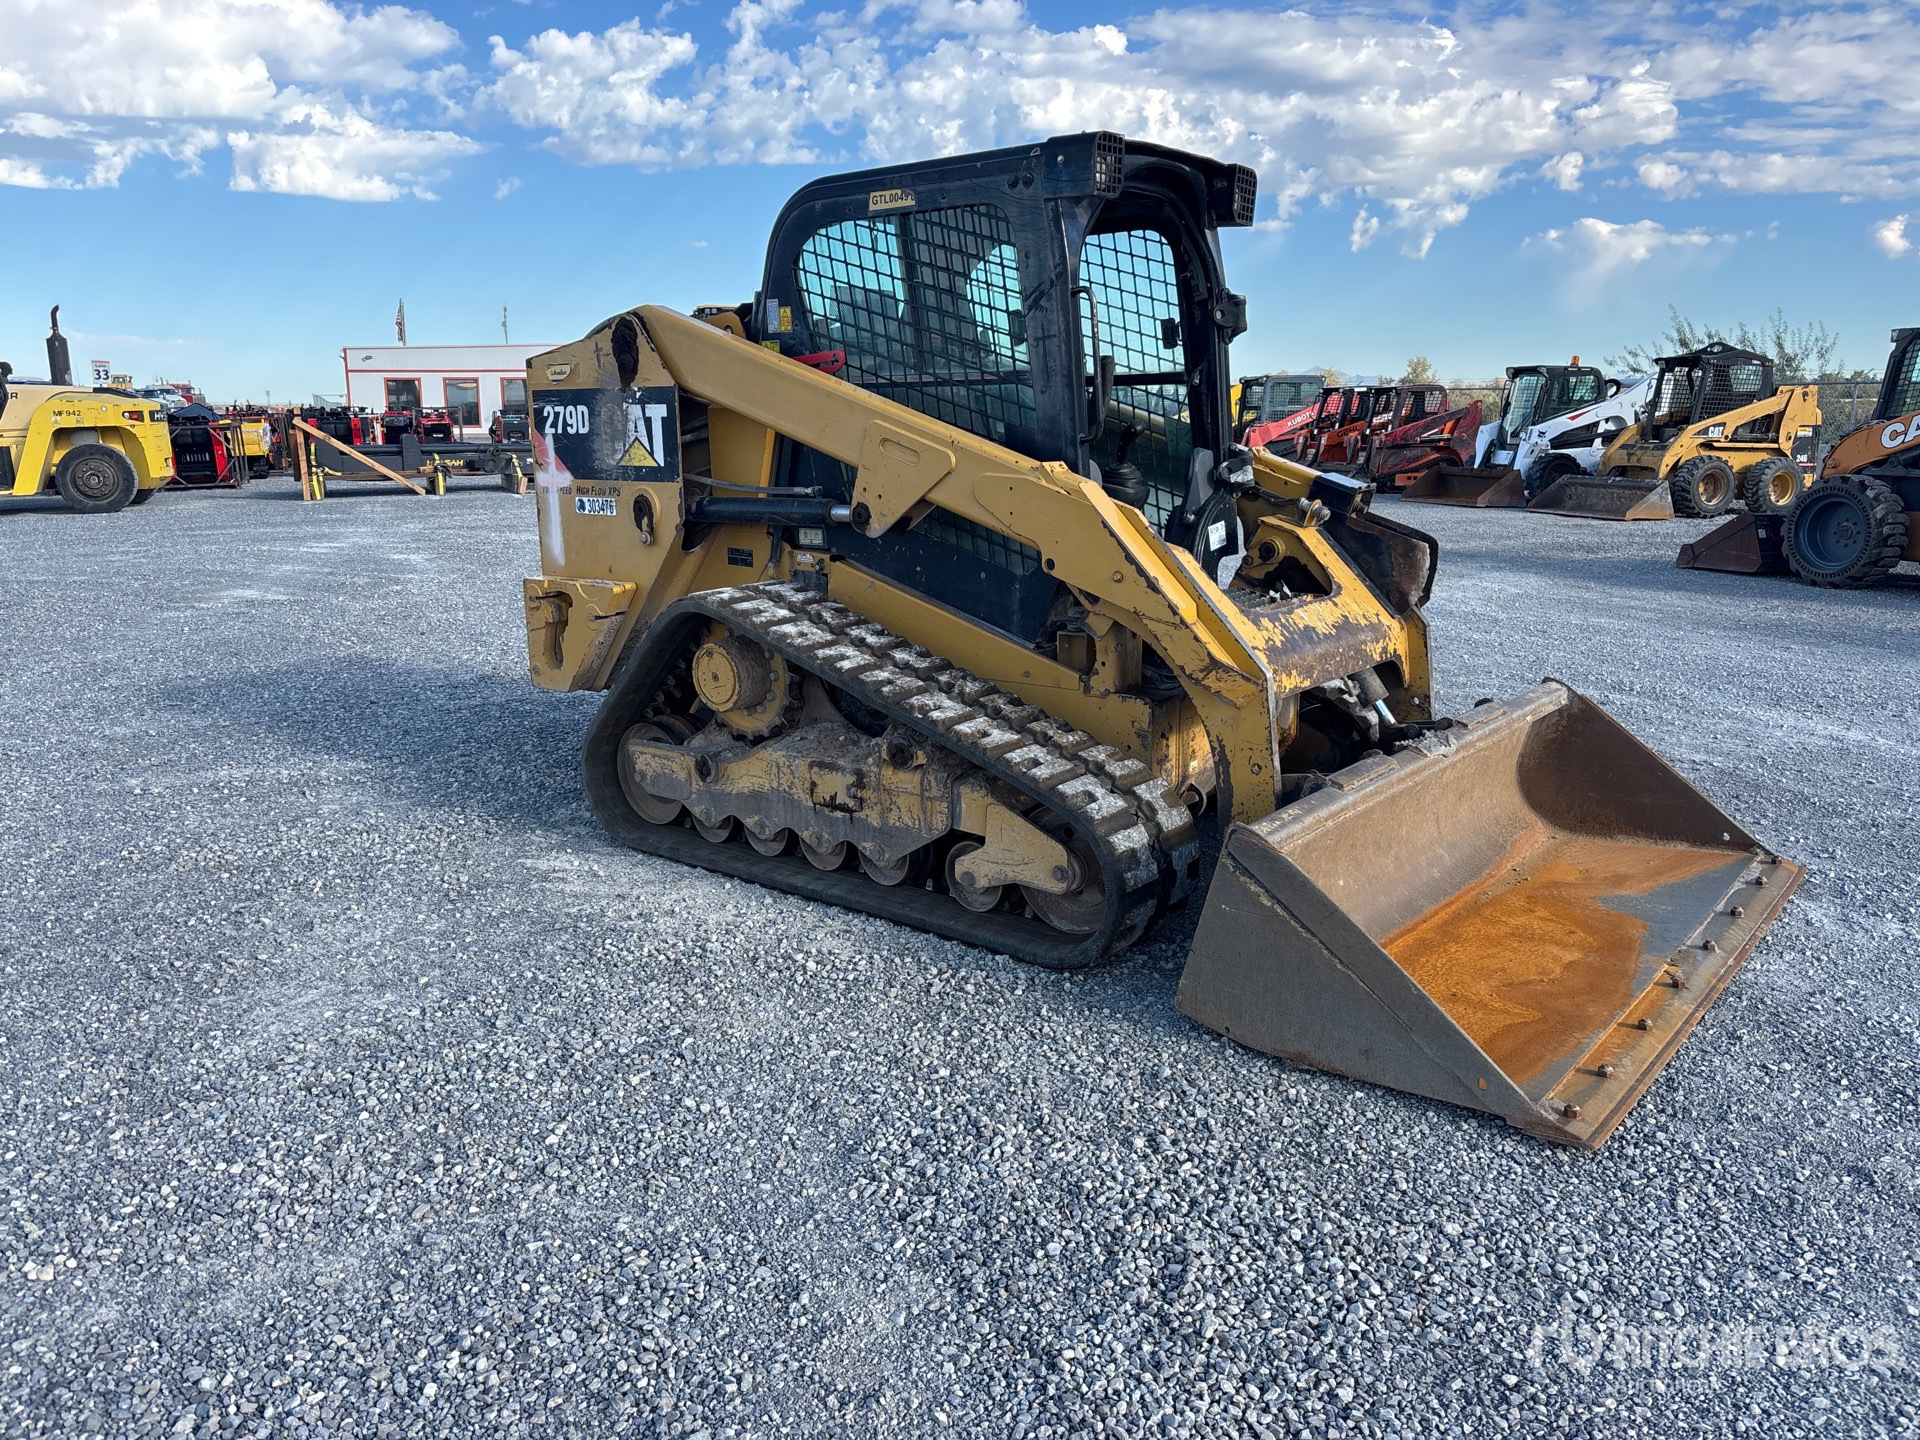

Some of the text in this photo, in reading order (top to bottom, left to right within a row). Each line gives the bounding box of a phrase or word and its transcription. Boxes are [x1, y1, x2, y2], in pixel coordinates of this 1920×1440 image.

[94, 369, 110, 380] 33
[543, 404, 590, 435] 279D
[1708, 426, 1724, 438] CAT
[1796, 454, 1808, 463] 246
[576, 485, 590, 495] HIGH
[591, 486, 607, 497] FLOW
[608, 486, 622, 497] XPS
[587, 498, 615, 515] 303476
